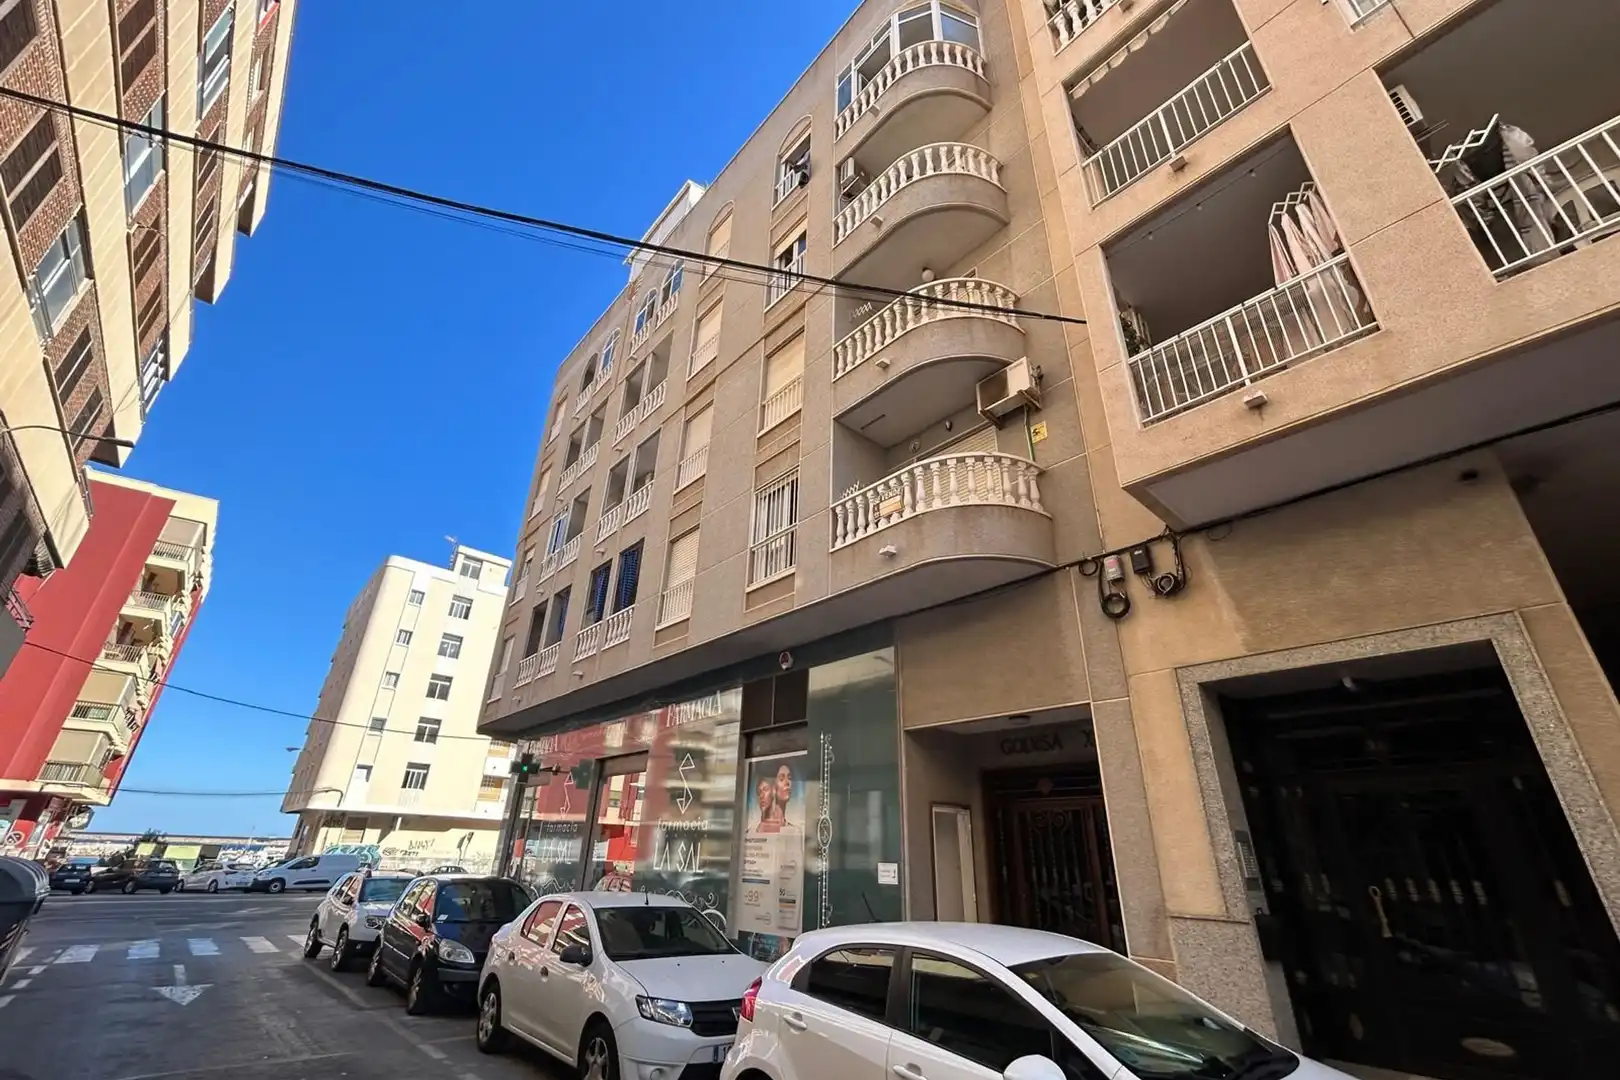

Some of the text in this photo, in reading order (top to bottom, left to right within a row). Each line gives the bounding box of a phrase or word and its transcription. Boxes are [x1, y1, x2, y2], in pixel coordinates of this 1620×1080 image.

[666, 690, 722, 727] FARMACIA
[657, 816, 708, 831] farmacia
[653, 841, 703, 872] LA SAL
